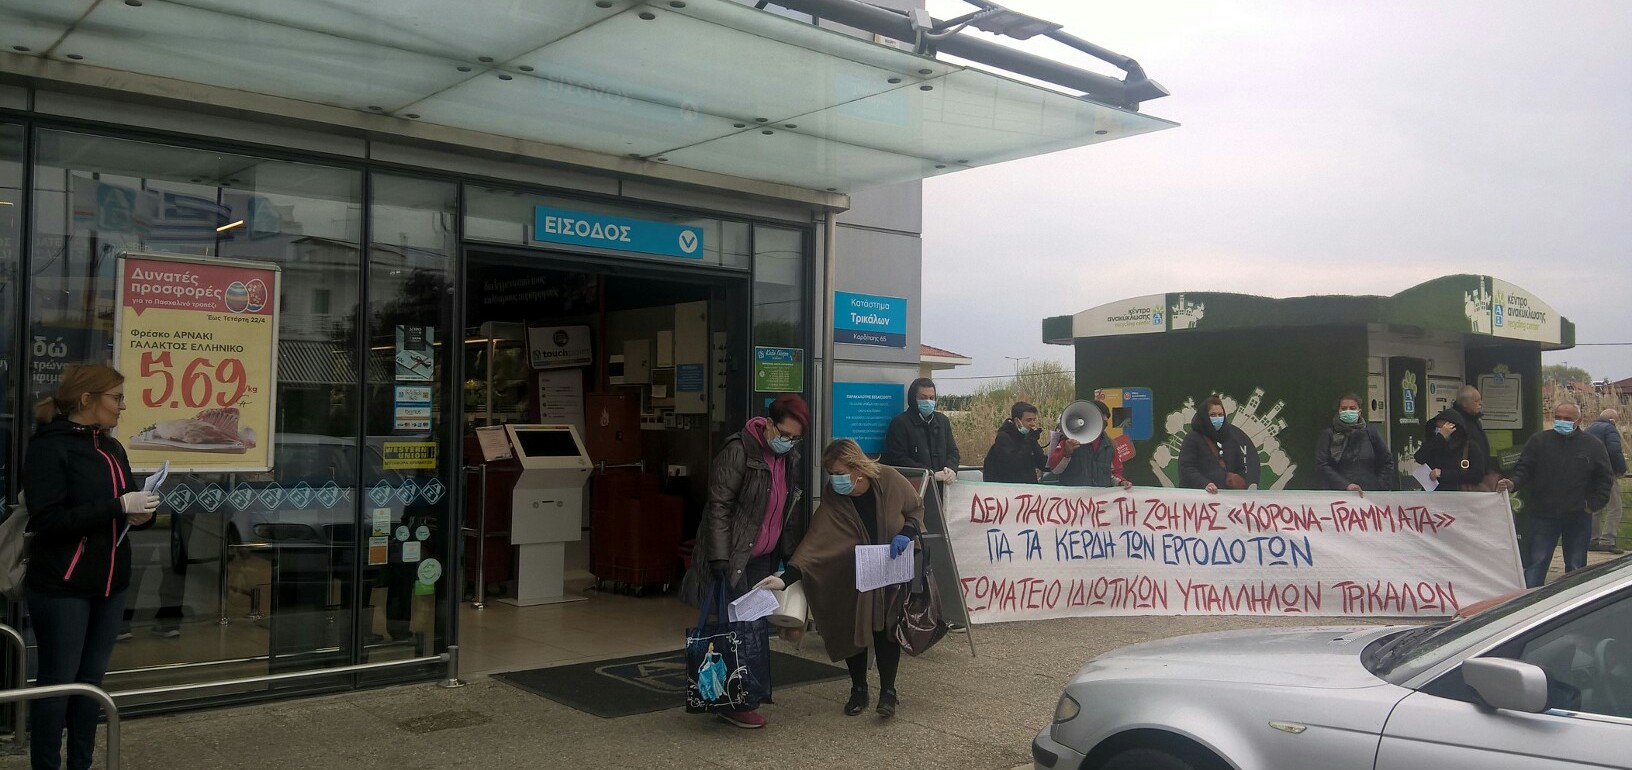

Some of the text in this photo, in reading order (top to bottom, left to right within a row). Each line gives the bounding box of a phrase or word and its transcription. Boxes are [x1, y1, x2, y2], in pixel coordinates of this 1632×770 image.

[545, 215, 631, 243] ΕΙΣΟΔΟΣ
[131, 267, 199, 286] Δυνατές
[131, 282, 223, 300] προσφορές
[154, 298, 191, 307] Πασχαλινό
[192, 301, 217, 309] τραπέζι
[850, 298, 890, 311] Κατάστημα
[1508, 292, 1527, 309] κέντρο
[1107, 313, 1151, 322] ανακύκλωσης
[1128, 306, 1151, 315] κέντρο
[1507, 306, 1546, 324] ανακύκλωσης
[224, 315, 249, 323] Τετάρτη
[250, 316, 266, 324] 22/4
[850, 312, 890, 326] Τρικάλων
[130, 329, 213, 340] Φρέσκο ΑΡΝΑΚΙ
[853, 333, 879, 343] Καρδίτσης
[130, 341, 244, 353] ΓΑΛΑΚΤΟΣ ΕΛΛΗΝΙΚΟ
[140, 351, 247, 409] 5.69
[970, 493, 1009, 525] ΔΕΝ
[1014, 494, 1110, 528] ΠΑΙΖΟΥΜΕ
[1113, 496, 1138, 527] ΤΗ
[987, 528, 1313, 568] ΓΙΑ ΤΑ ΚΕΡΔΗ ΤΩΝ ΕΡΓΟΔΟΤΩΝ
[960, 575, 1460, 614] ΣΩΜΑΤΕΙΟ ΙΔΙΩΤΙΚΩΝ ΥΠΑΛΛΗΛΩΝ ΤΡΙΚΑΛΩΝ
